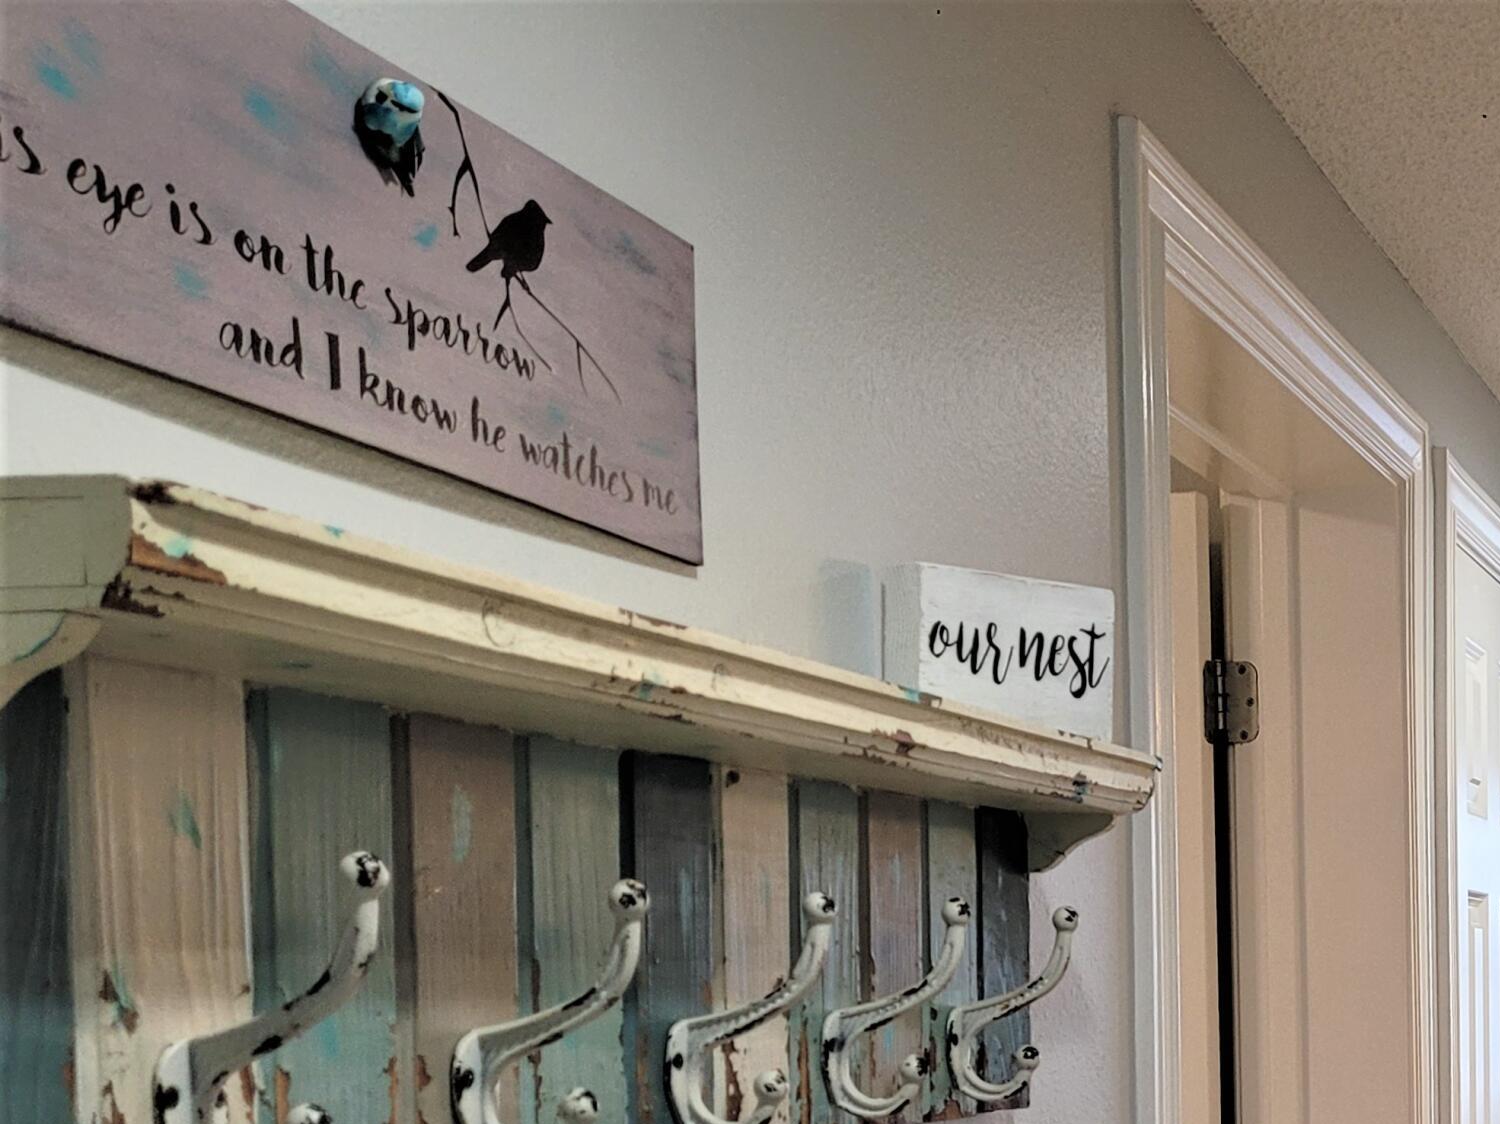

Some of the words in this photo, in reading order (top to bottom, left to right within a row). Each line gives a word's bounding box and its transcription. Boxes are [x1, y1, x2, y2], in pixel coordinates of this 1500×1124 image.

[67, 158, 152, 235] eye
[166, 183, 217, 245] is
[234, 229, 292, 275] on
[301, 233, 367, 310] the
[384, 287, 535, 380] sparrow
[219, 316, 304, 380] and
[324, 331, 342, 390] I
[359, 347, 457, 433] know
[471, 396, 506, 452] he
[519, 431, 634, 503] watches
[643, 477, 678, 515] me
[928, 620, 1014, 685] our
[1019, 623, 1110, 698] nest
